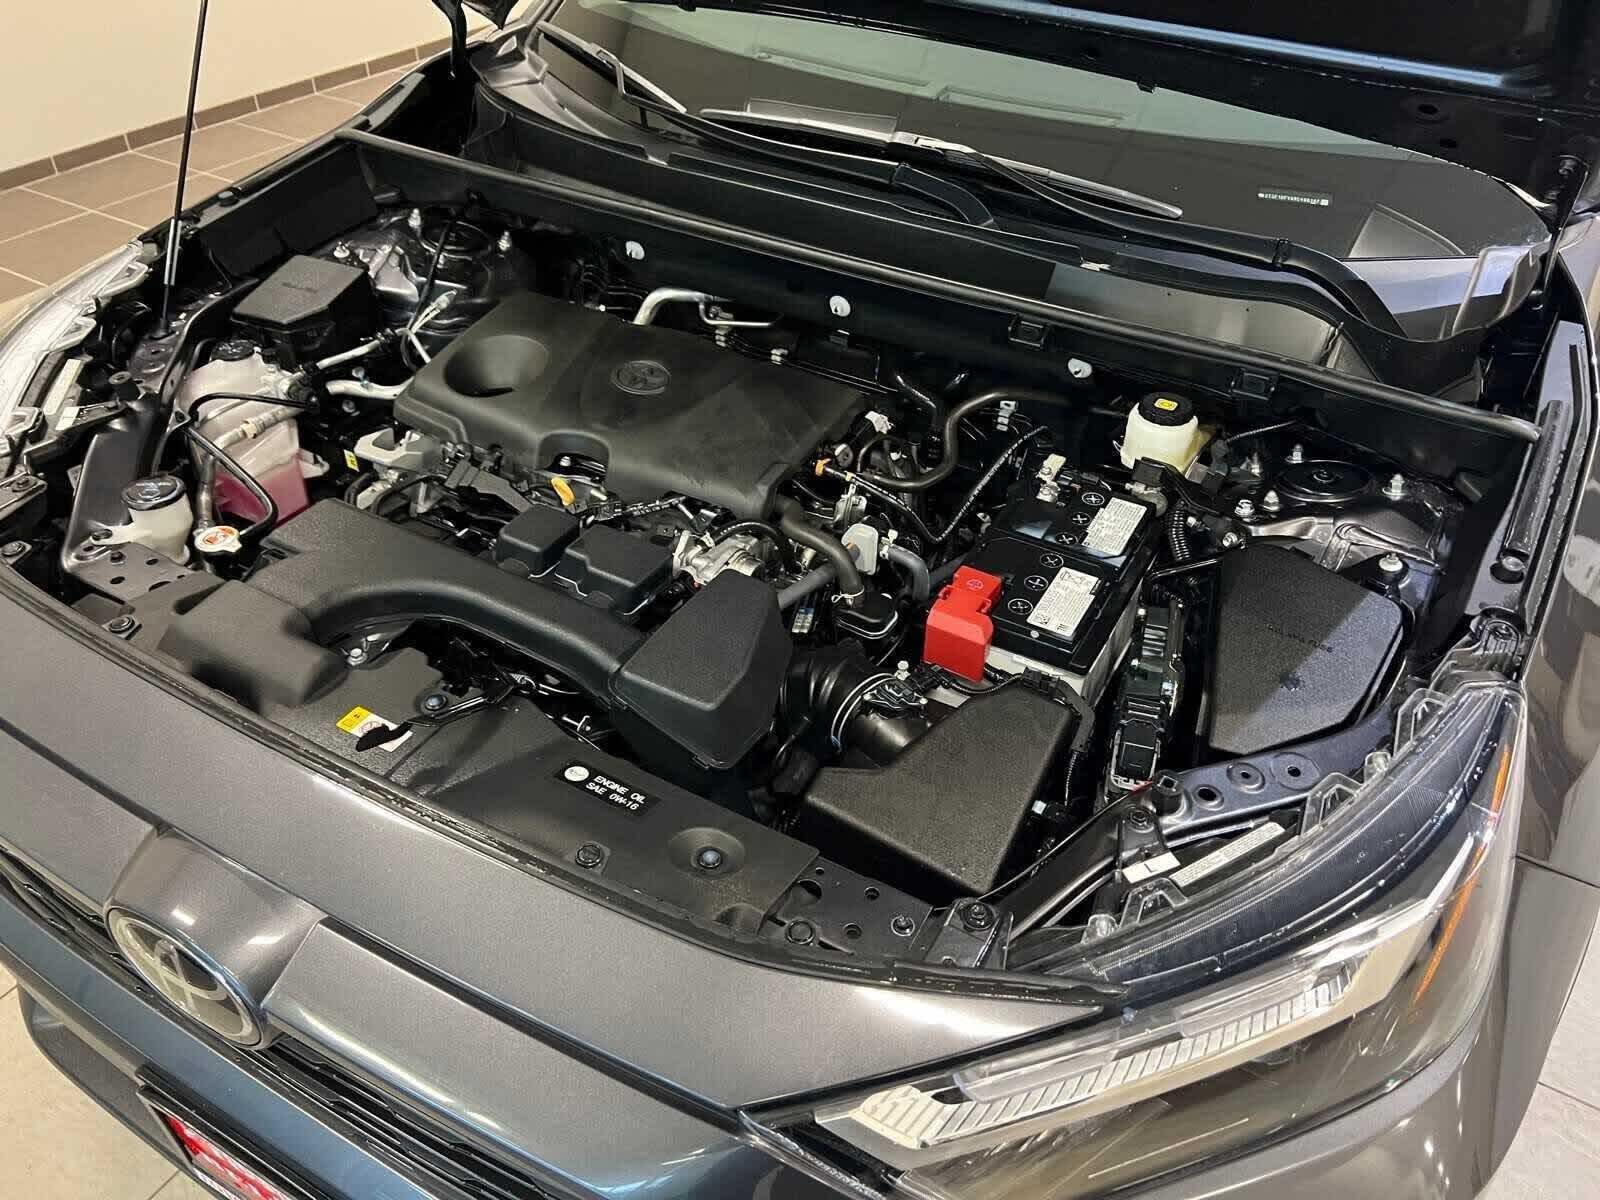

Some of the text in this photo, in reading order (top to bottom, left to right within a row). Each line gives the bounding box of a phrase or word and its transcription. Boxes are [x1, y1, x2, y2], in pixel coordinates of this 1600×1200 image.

[585, 782, 640, 810] SAE 0W-16
[593, 775, 646, 805] ENGINE OIL
